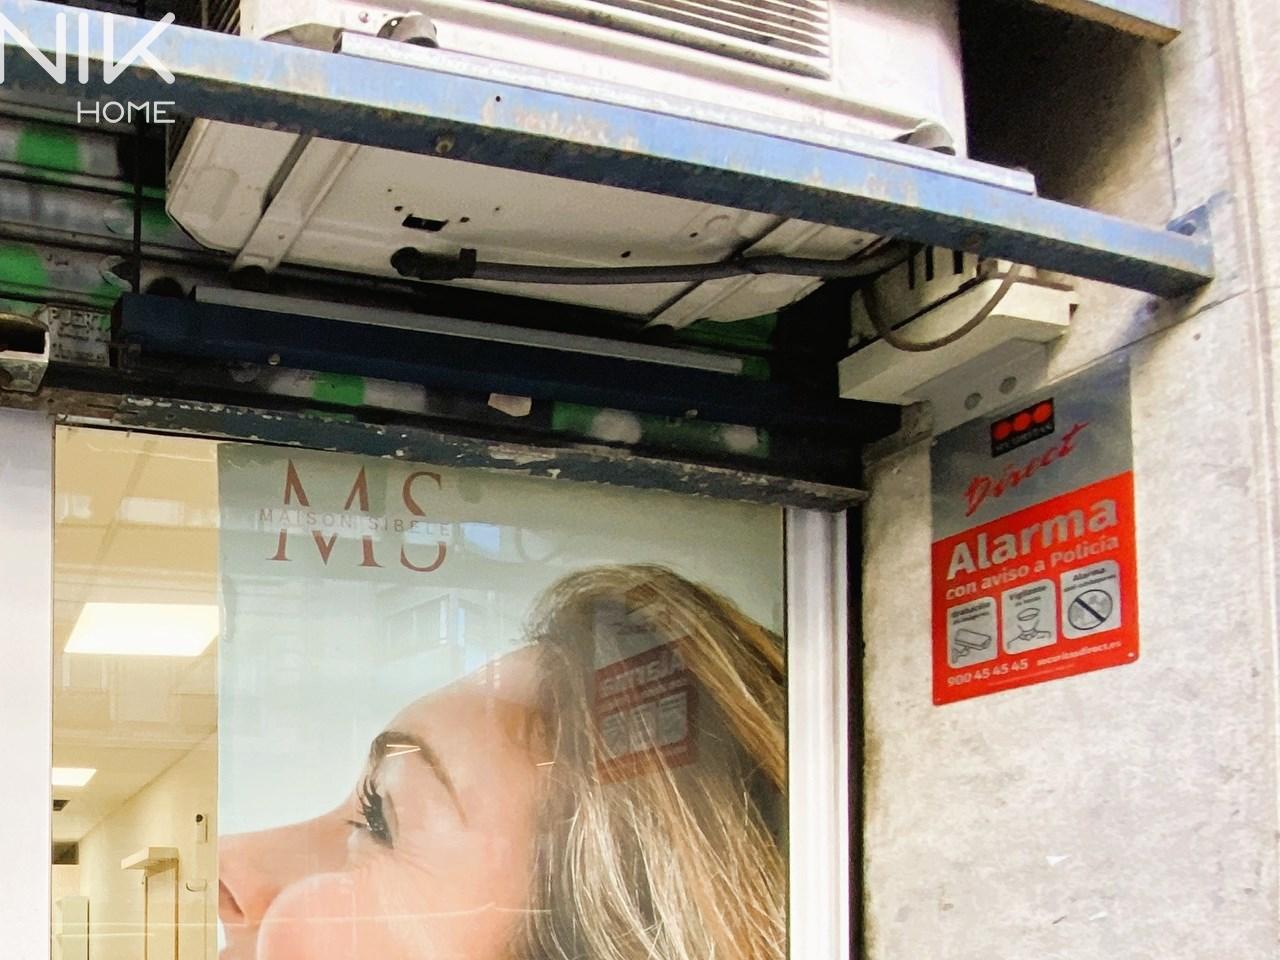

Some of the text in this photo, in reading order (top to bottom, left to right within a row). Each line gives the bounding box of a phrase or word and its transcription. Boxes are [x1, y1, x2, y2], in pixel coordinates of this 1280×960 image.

[960, 421, 1089, 517] Direct
[259, 508, 353, 529] MAISON
[946, 499, 1119, 581] Alarma
[946, 581, 977, 601] con
[981, 564, 1030, 590] aviso
[1033, 559, 1046, 573] a
[973, 666, 991, 681] 45
[992, 662, 1010, 677] 45
[1011, 657, 1029, 672] 45
